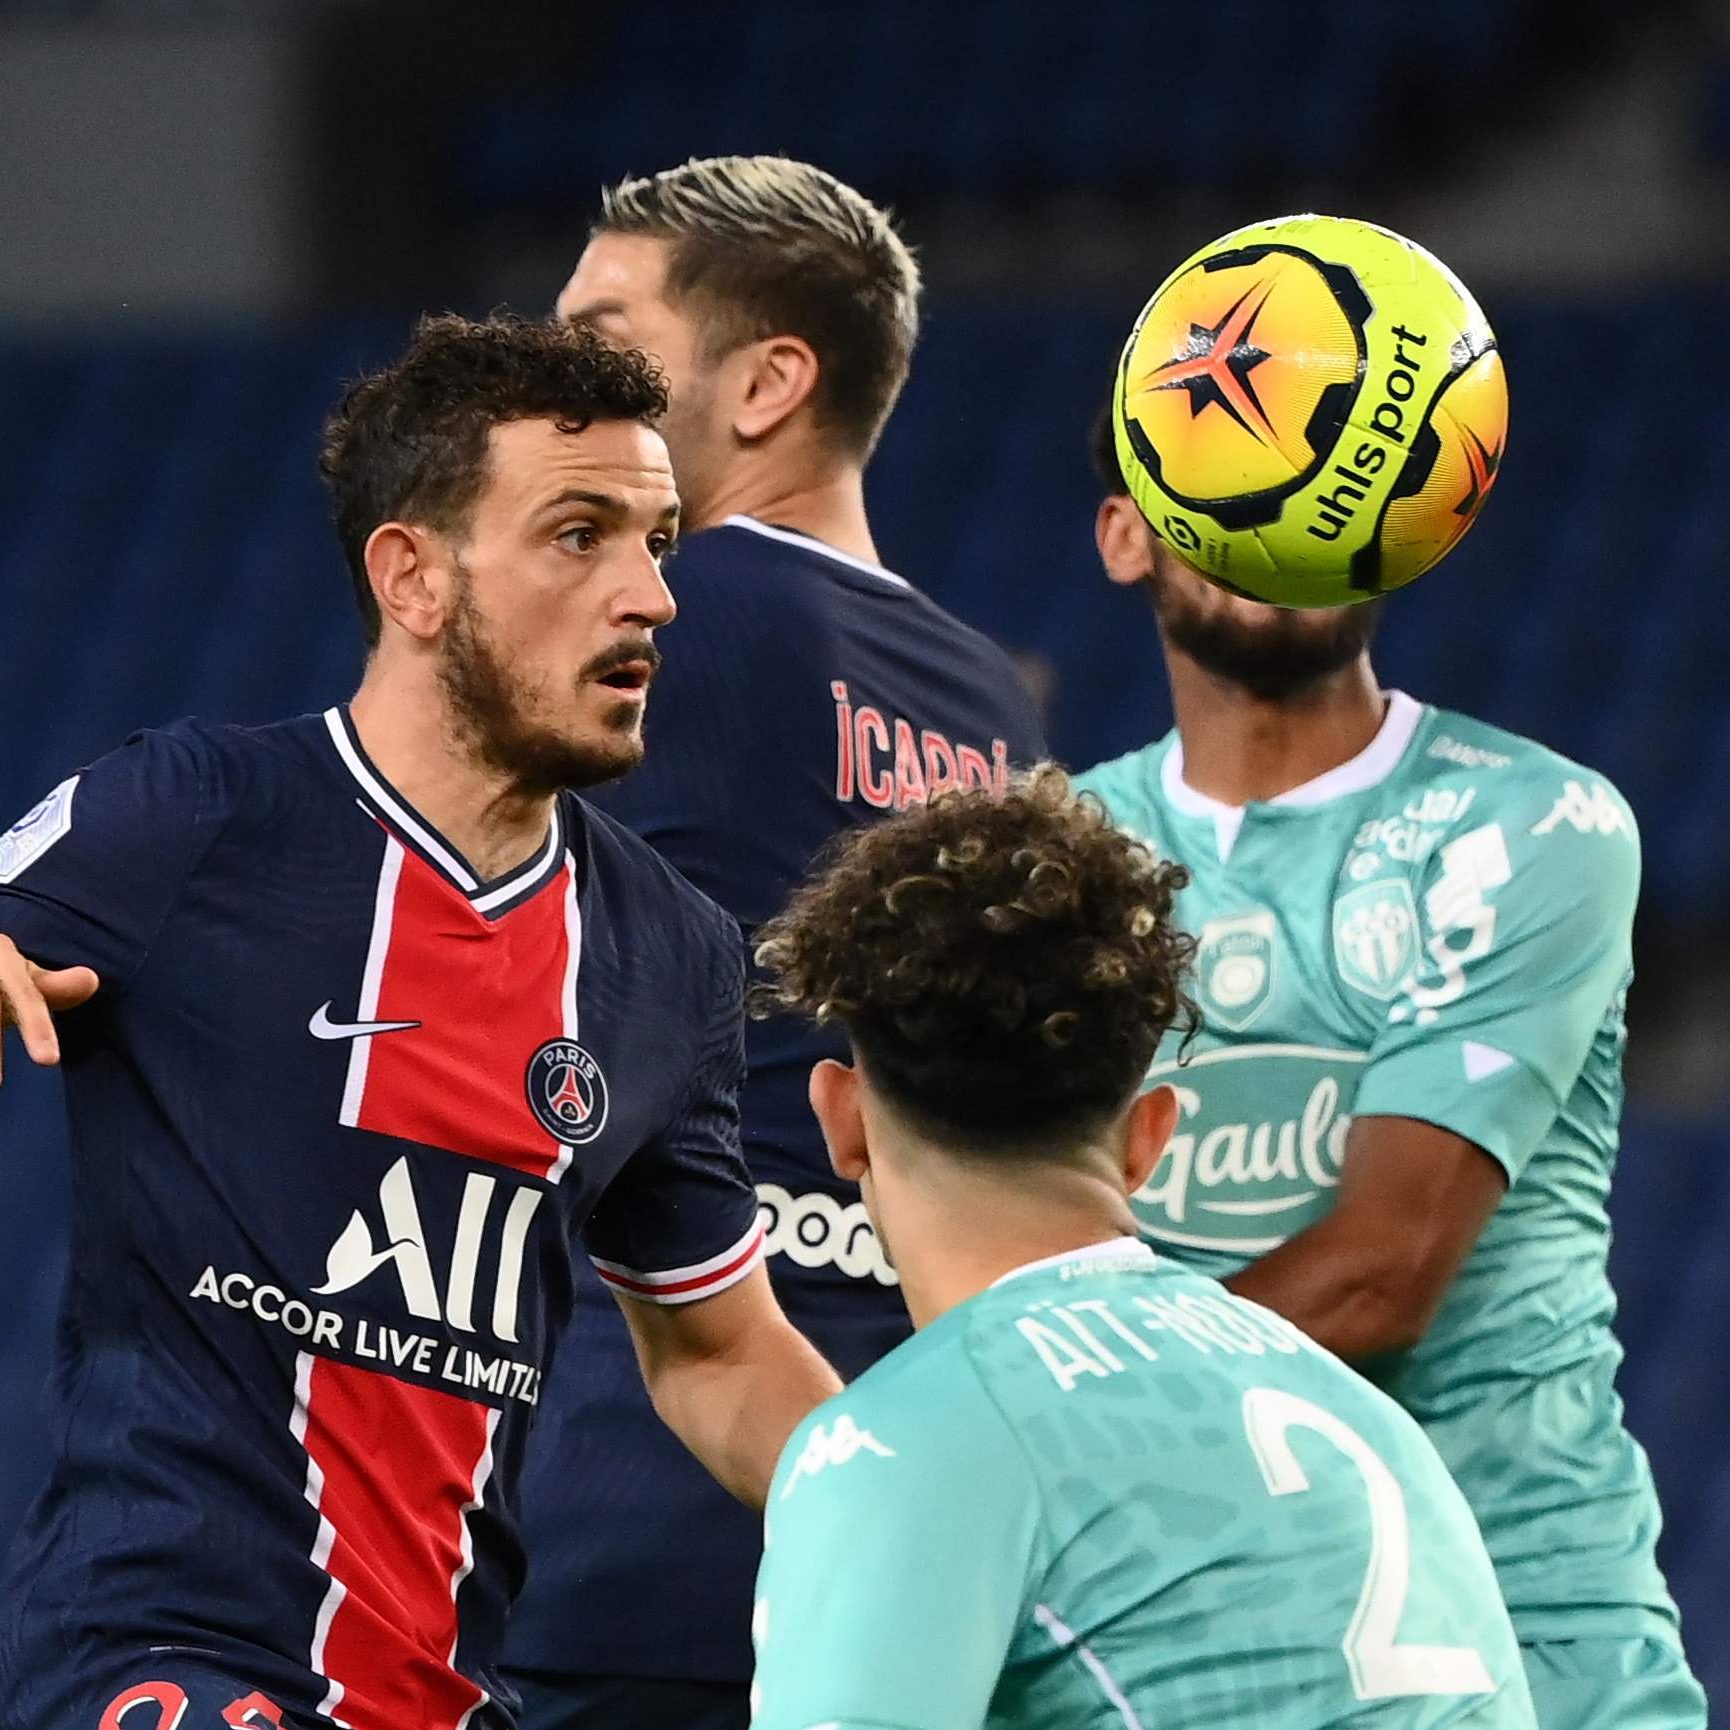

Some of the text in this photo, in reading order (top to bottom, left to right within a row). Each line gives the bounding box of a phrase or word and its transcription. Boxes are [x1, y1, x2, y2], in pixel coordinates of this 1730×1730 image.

[1306, 323, 1427, 542] uhlsport
[542, 1046, 597, 1081] PARIS
[189, 1264, 344, 1350] ACCOR
[354, 1320, 439, 1374] LIVE
[1241, 1387, 1497, 1701] 2
